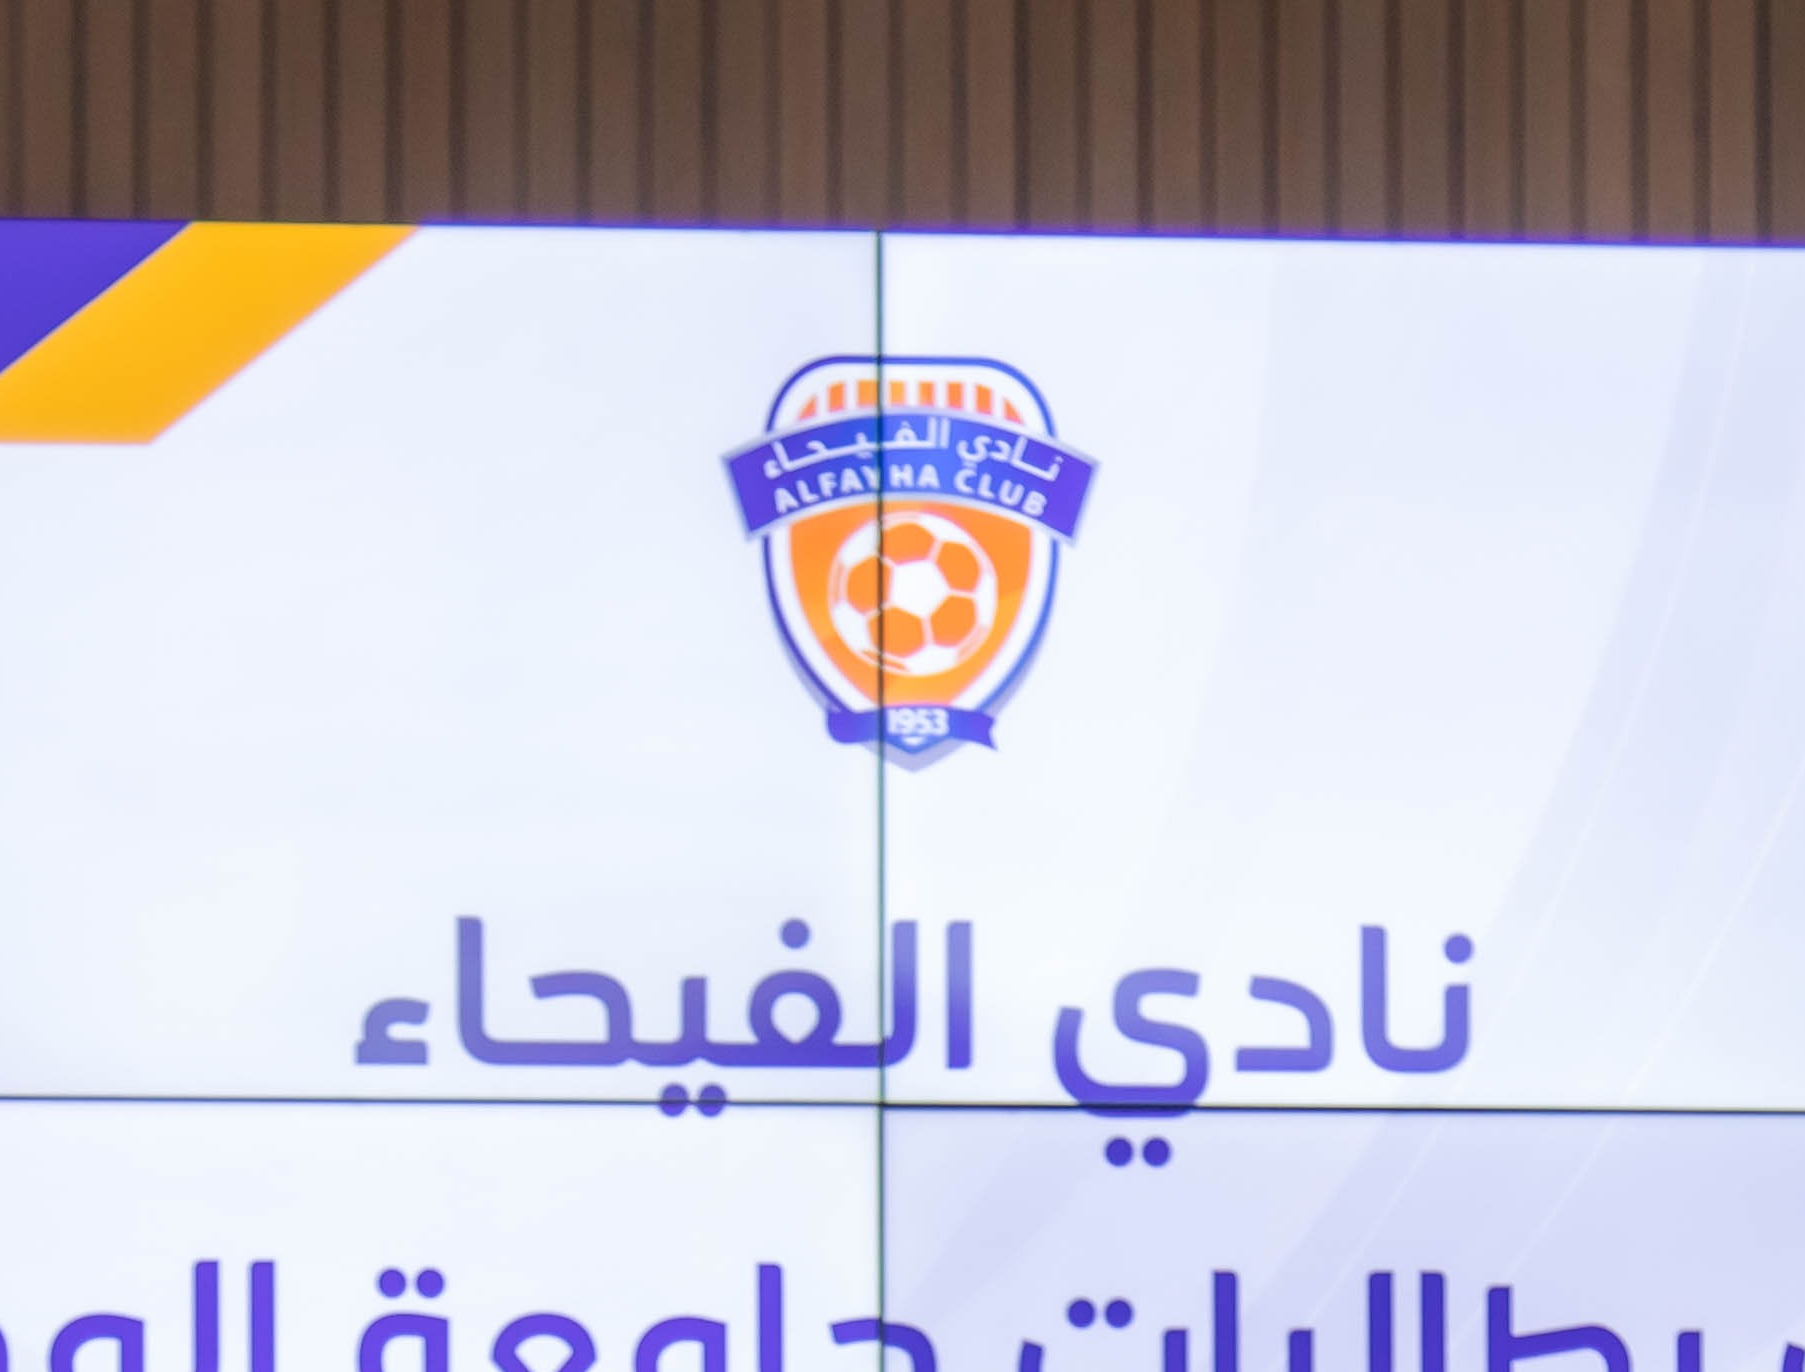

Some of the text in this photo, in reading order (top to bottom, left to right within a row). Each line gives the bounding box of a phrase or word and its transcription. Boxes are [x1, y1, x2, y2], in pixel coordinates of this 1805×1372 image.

[762, 415, 1064, 482] نادي الفيحاء
[773, 462, 1048, 518] ALFAYHA CLUB
[887, 708, 950, 736] 1953
[353, 914, 1474, 1170] نادي الفيحاء
